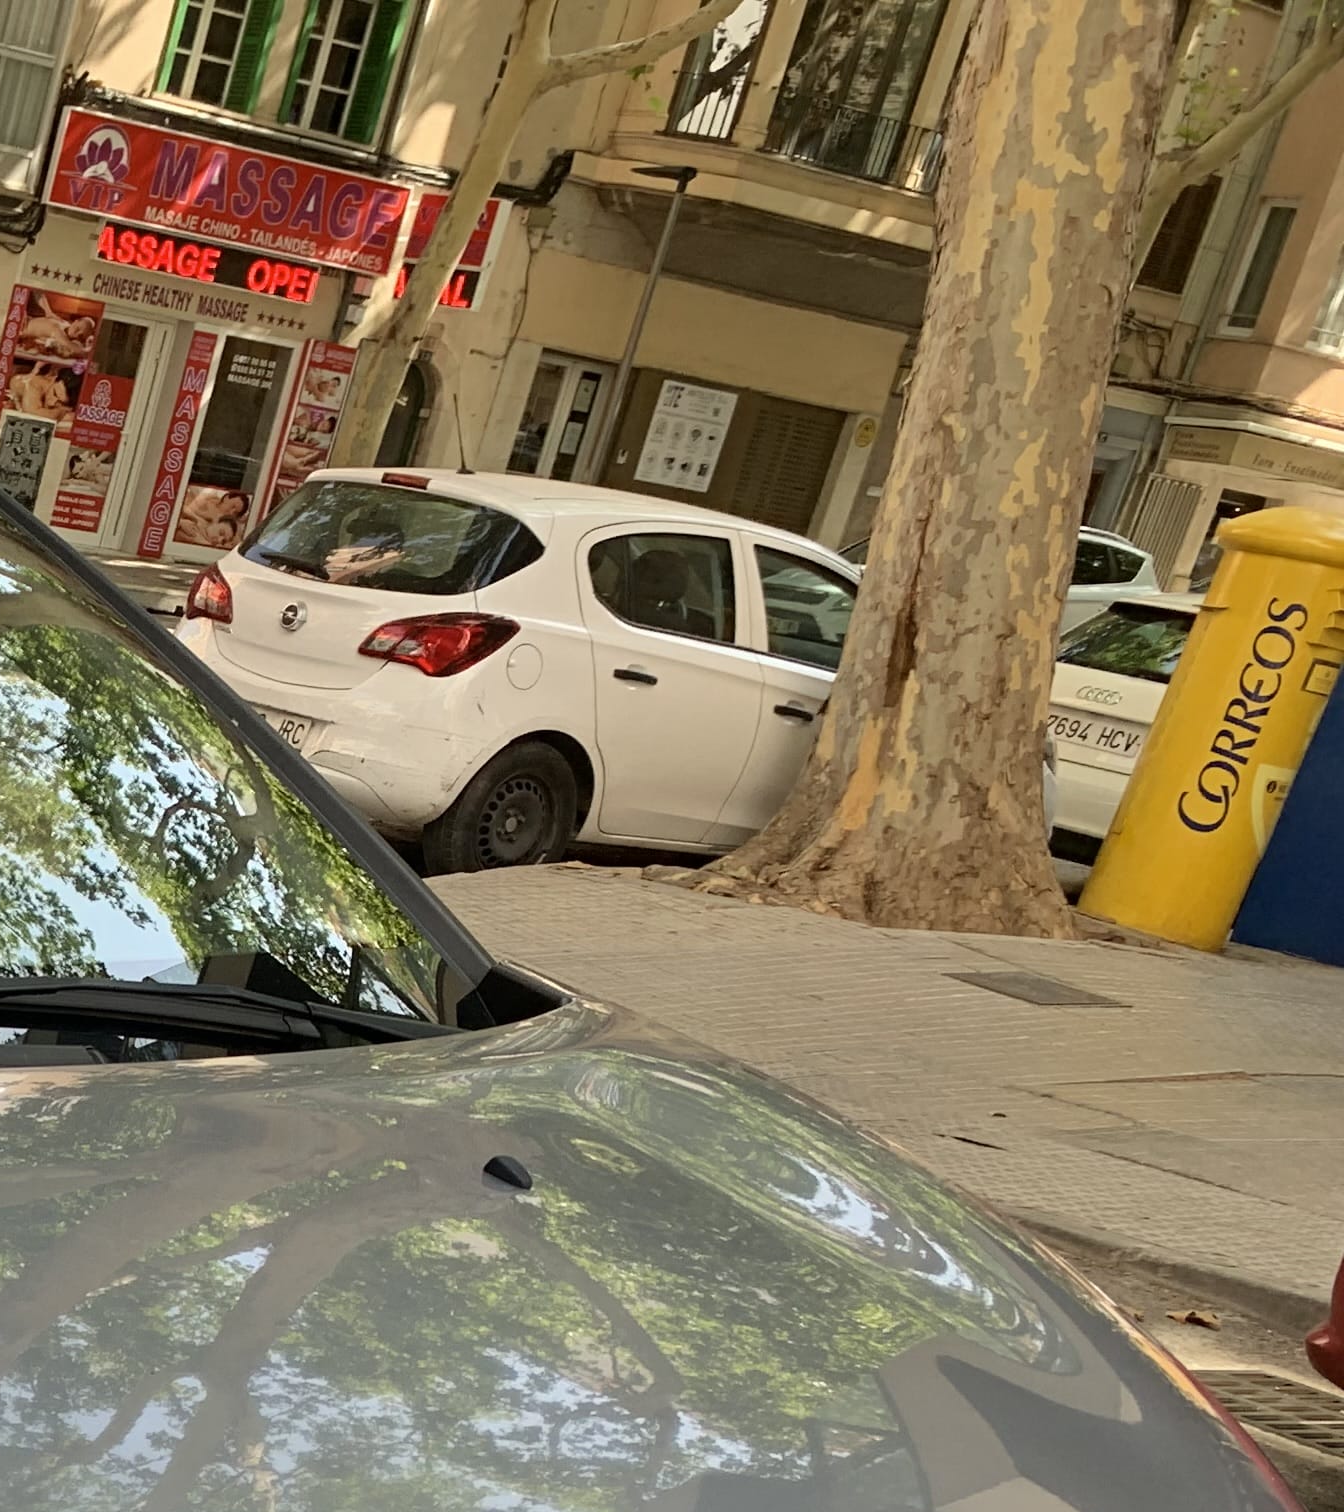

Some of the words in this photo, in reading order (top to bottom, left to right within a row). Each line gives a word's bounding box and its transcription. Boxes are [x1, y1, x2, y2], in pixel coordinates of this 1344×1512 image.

[69, 178, 124, 211] VIP
[150, 139, 404, 249] MASSAGE
[144, 206, 197, 230] MASAJE
[199, 216, 241, 239] CHINO
[93, 273, 141, 301] CHINESE
[142, 284, 194, 312] HEALTHY
[195, 295, 249, 322] MASSAGE
[143, 366, 206, 551] MASSAGE
[1047, 714, 1093, 742] 7694
[1095, 727, 1140, 752] HCV
[1177, 597, 1309, 833] CORREOS
